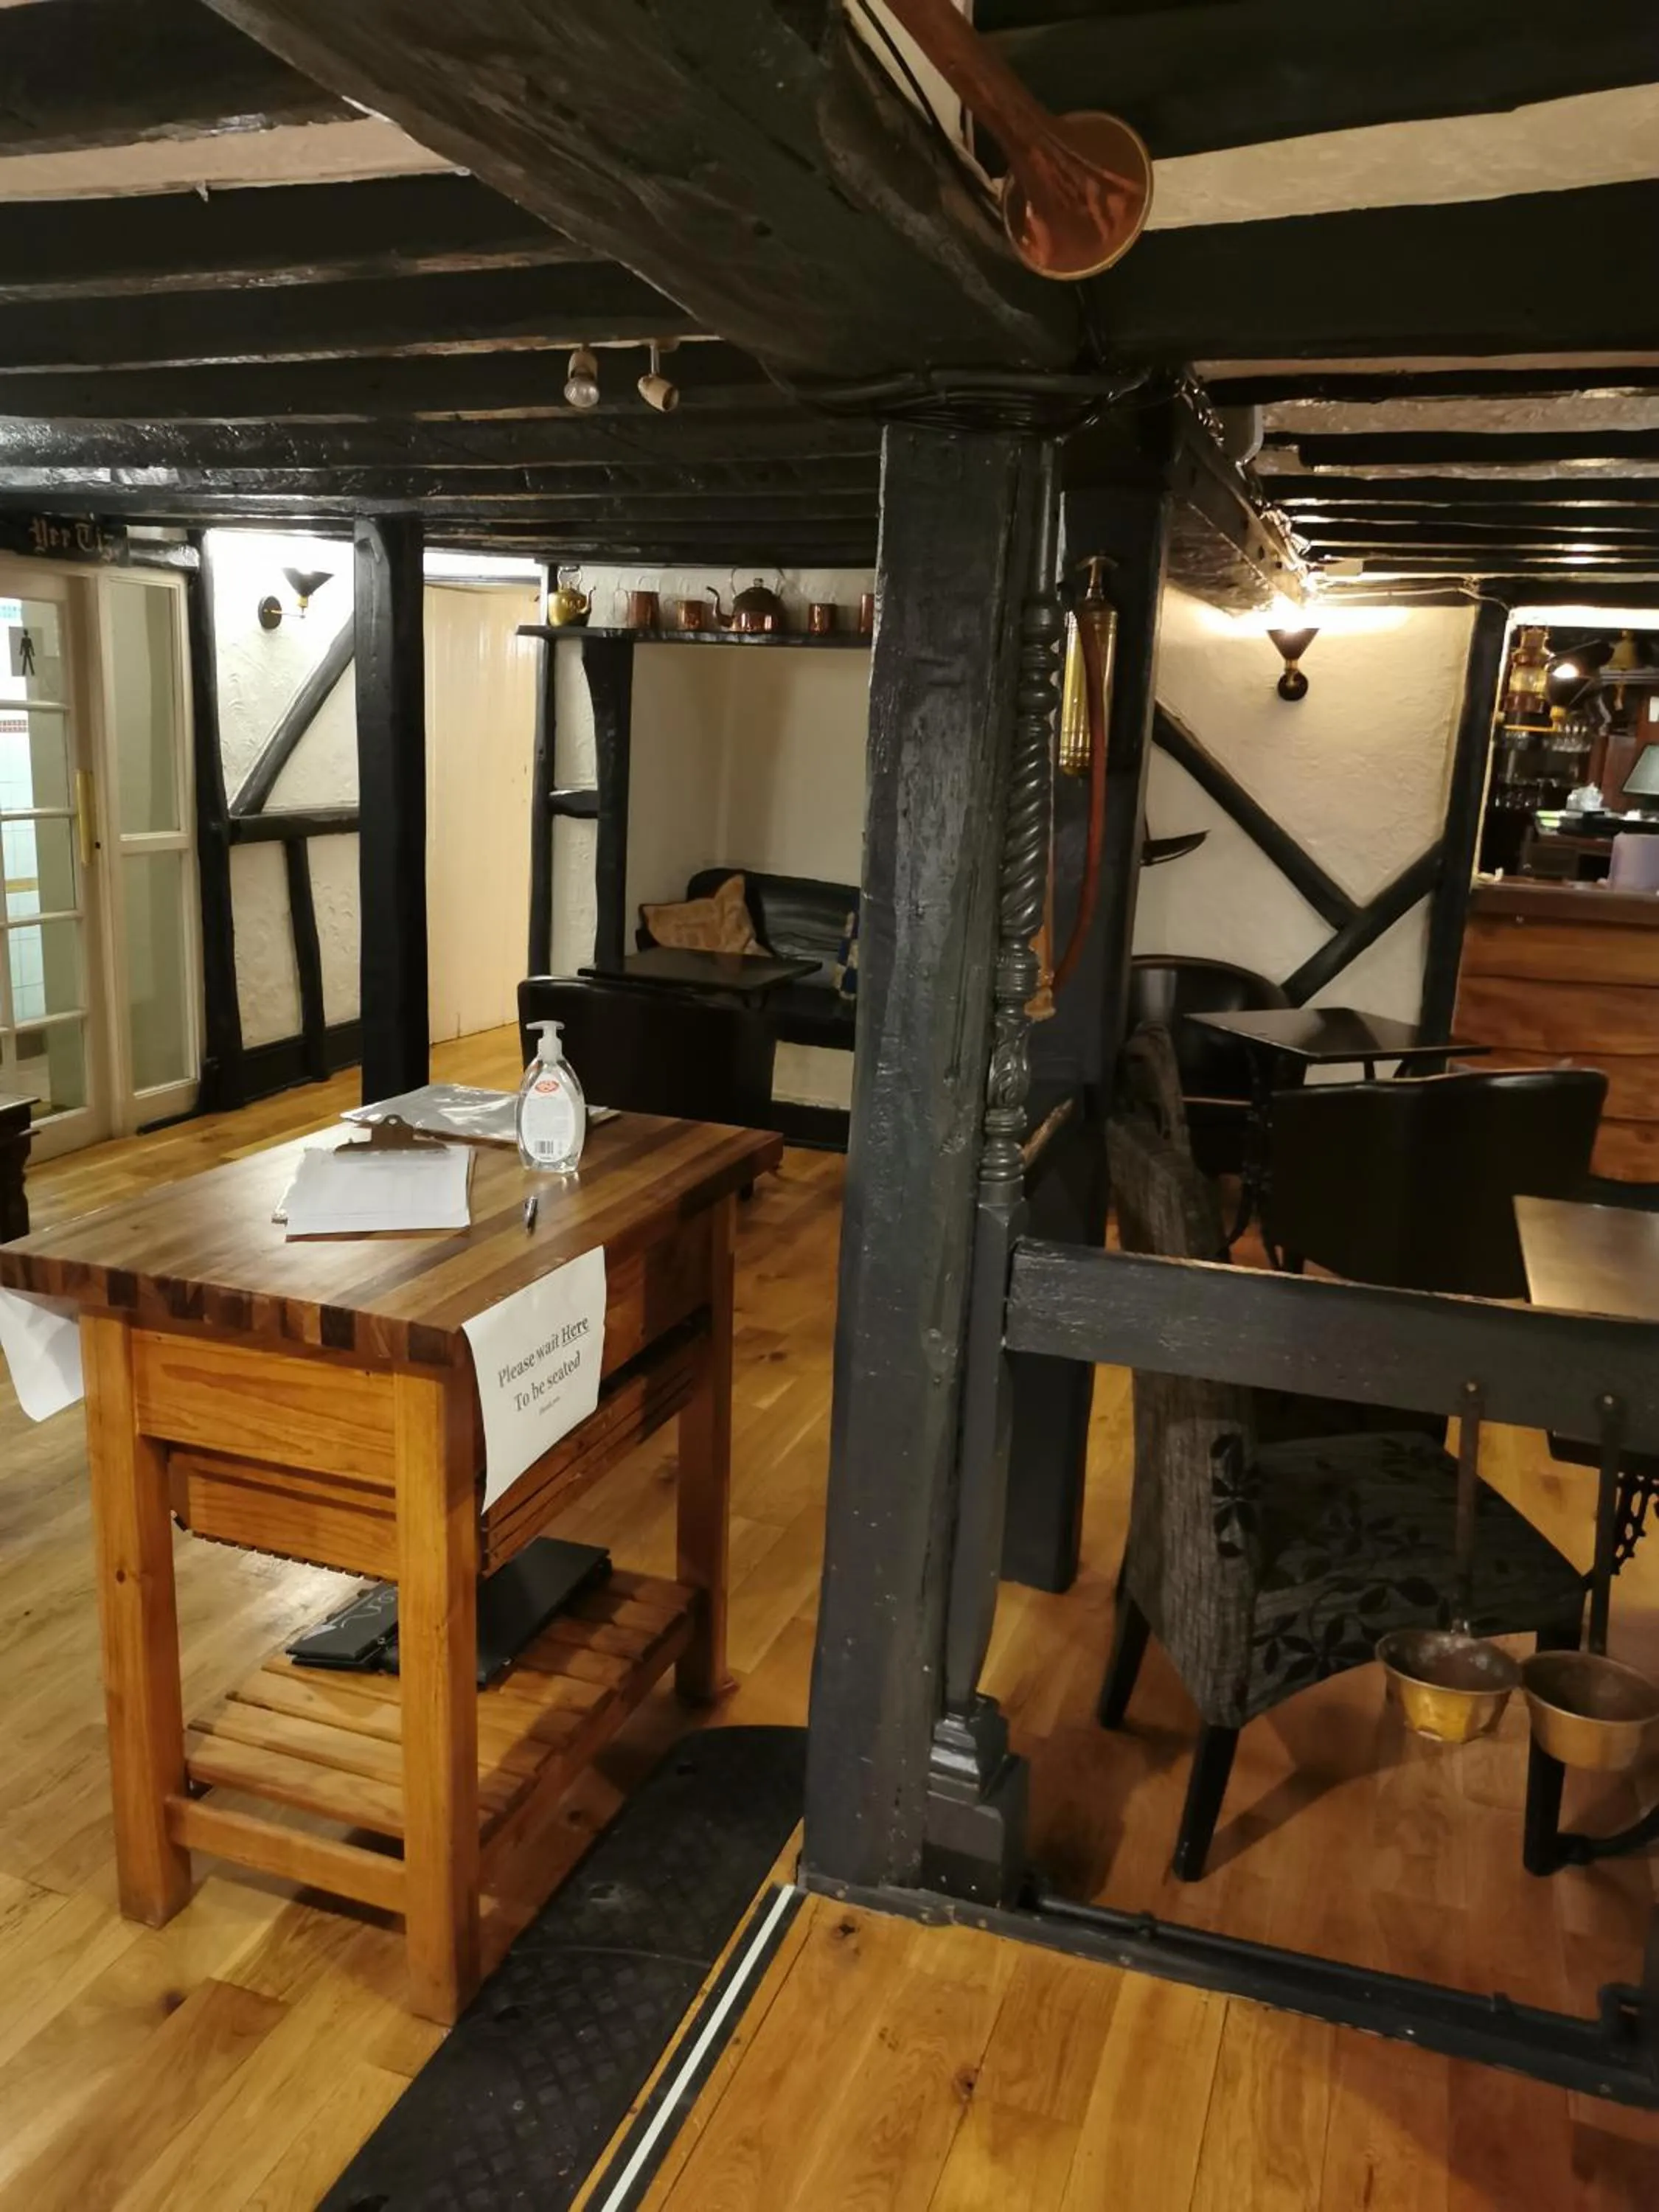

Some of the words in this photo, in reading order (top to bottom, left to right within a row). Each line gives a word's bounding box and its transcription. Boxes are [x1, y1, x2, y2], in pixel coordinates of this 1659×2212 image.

[498, 1353, 535, 1388] Please
[536, 1333, 560, 1360] wait
[561, 1317, 589, 1345] Here
[514, 1391, 530, 1411] To
[531, 1381, 545, 1400] be
[546, 1349, 581, 1389] seated
